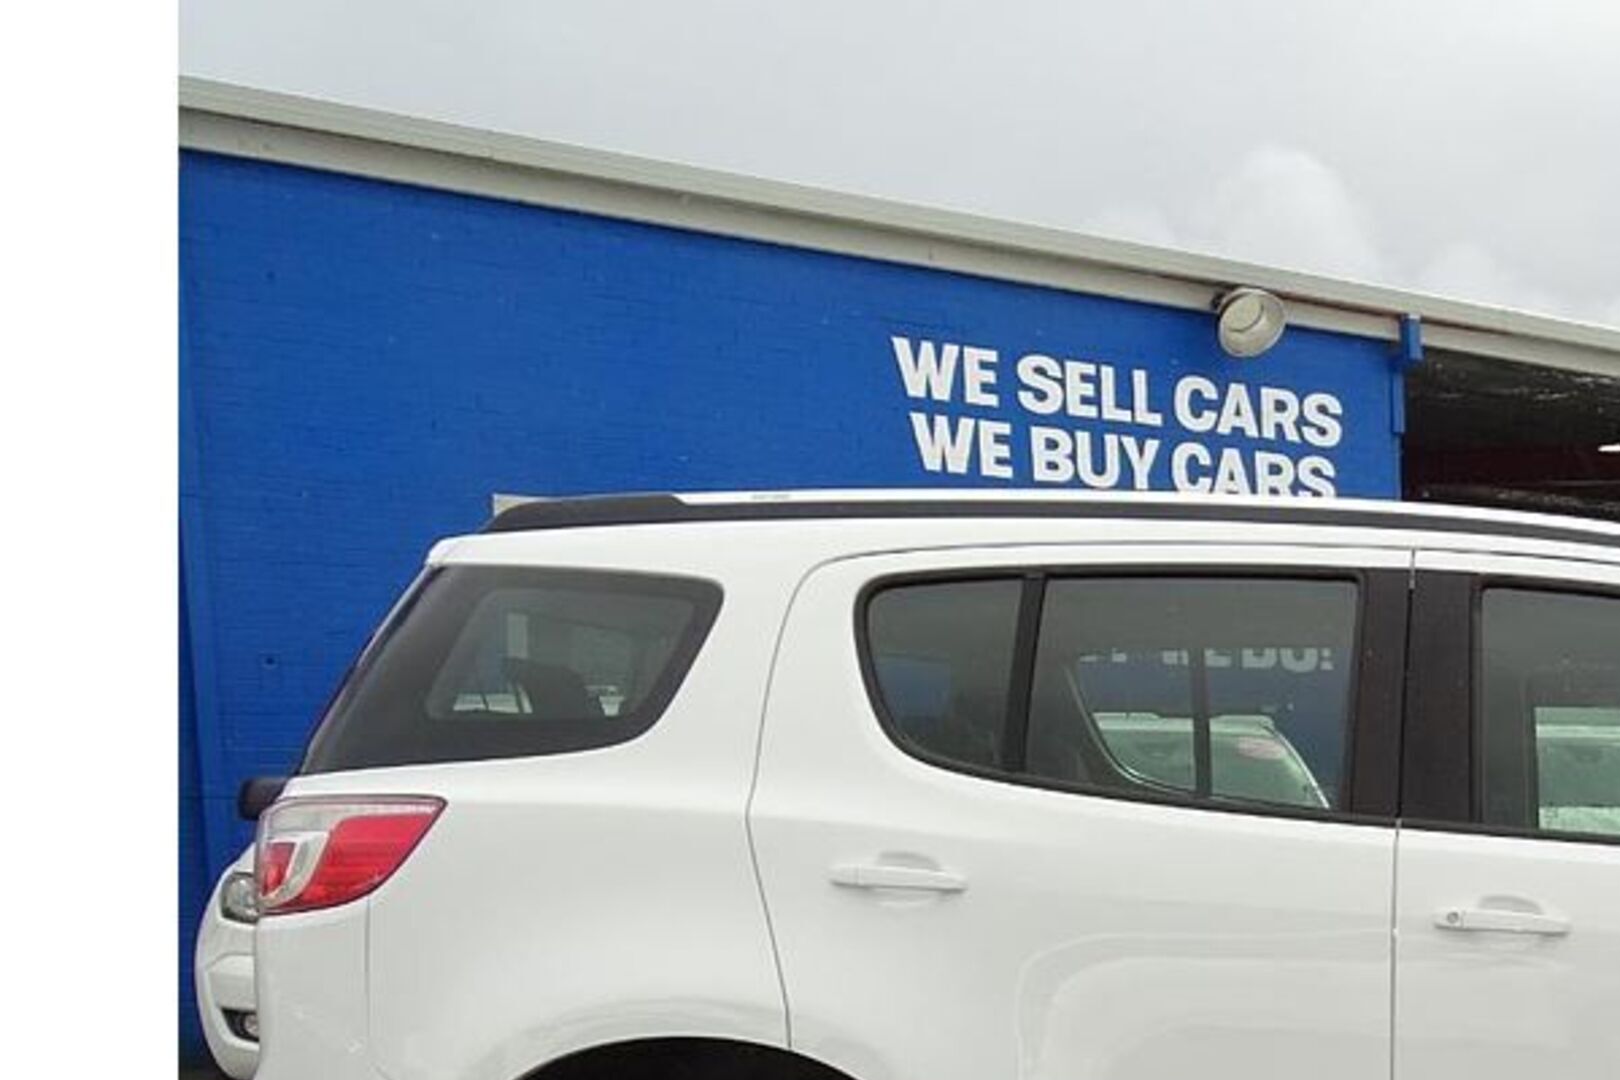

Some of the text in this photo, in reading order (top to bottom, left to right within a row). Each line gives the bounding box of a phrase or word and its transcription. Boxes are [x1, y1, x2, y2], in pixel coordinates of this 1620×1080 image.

[891, 336, 1343, 448] WE SELL CARS
[909, 411, 1337, 498] WE BUY CARS
